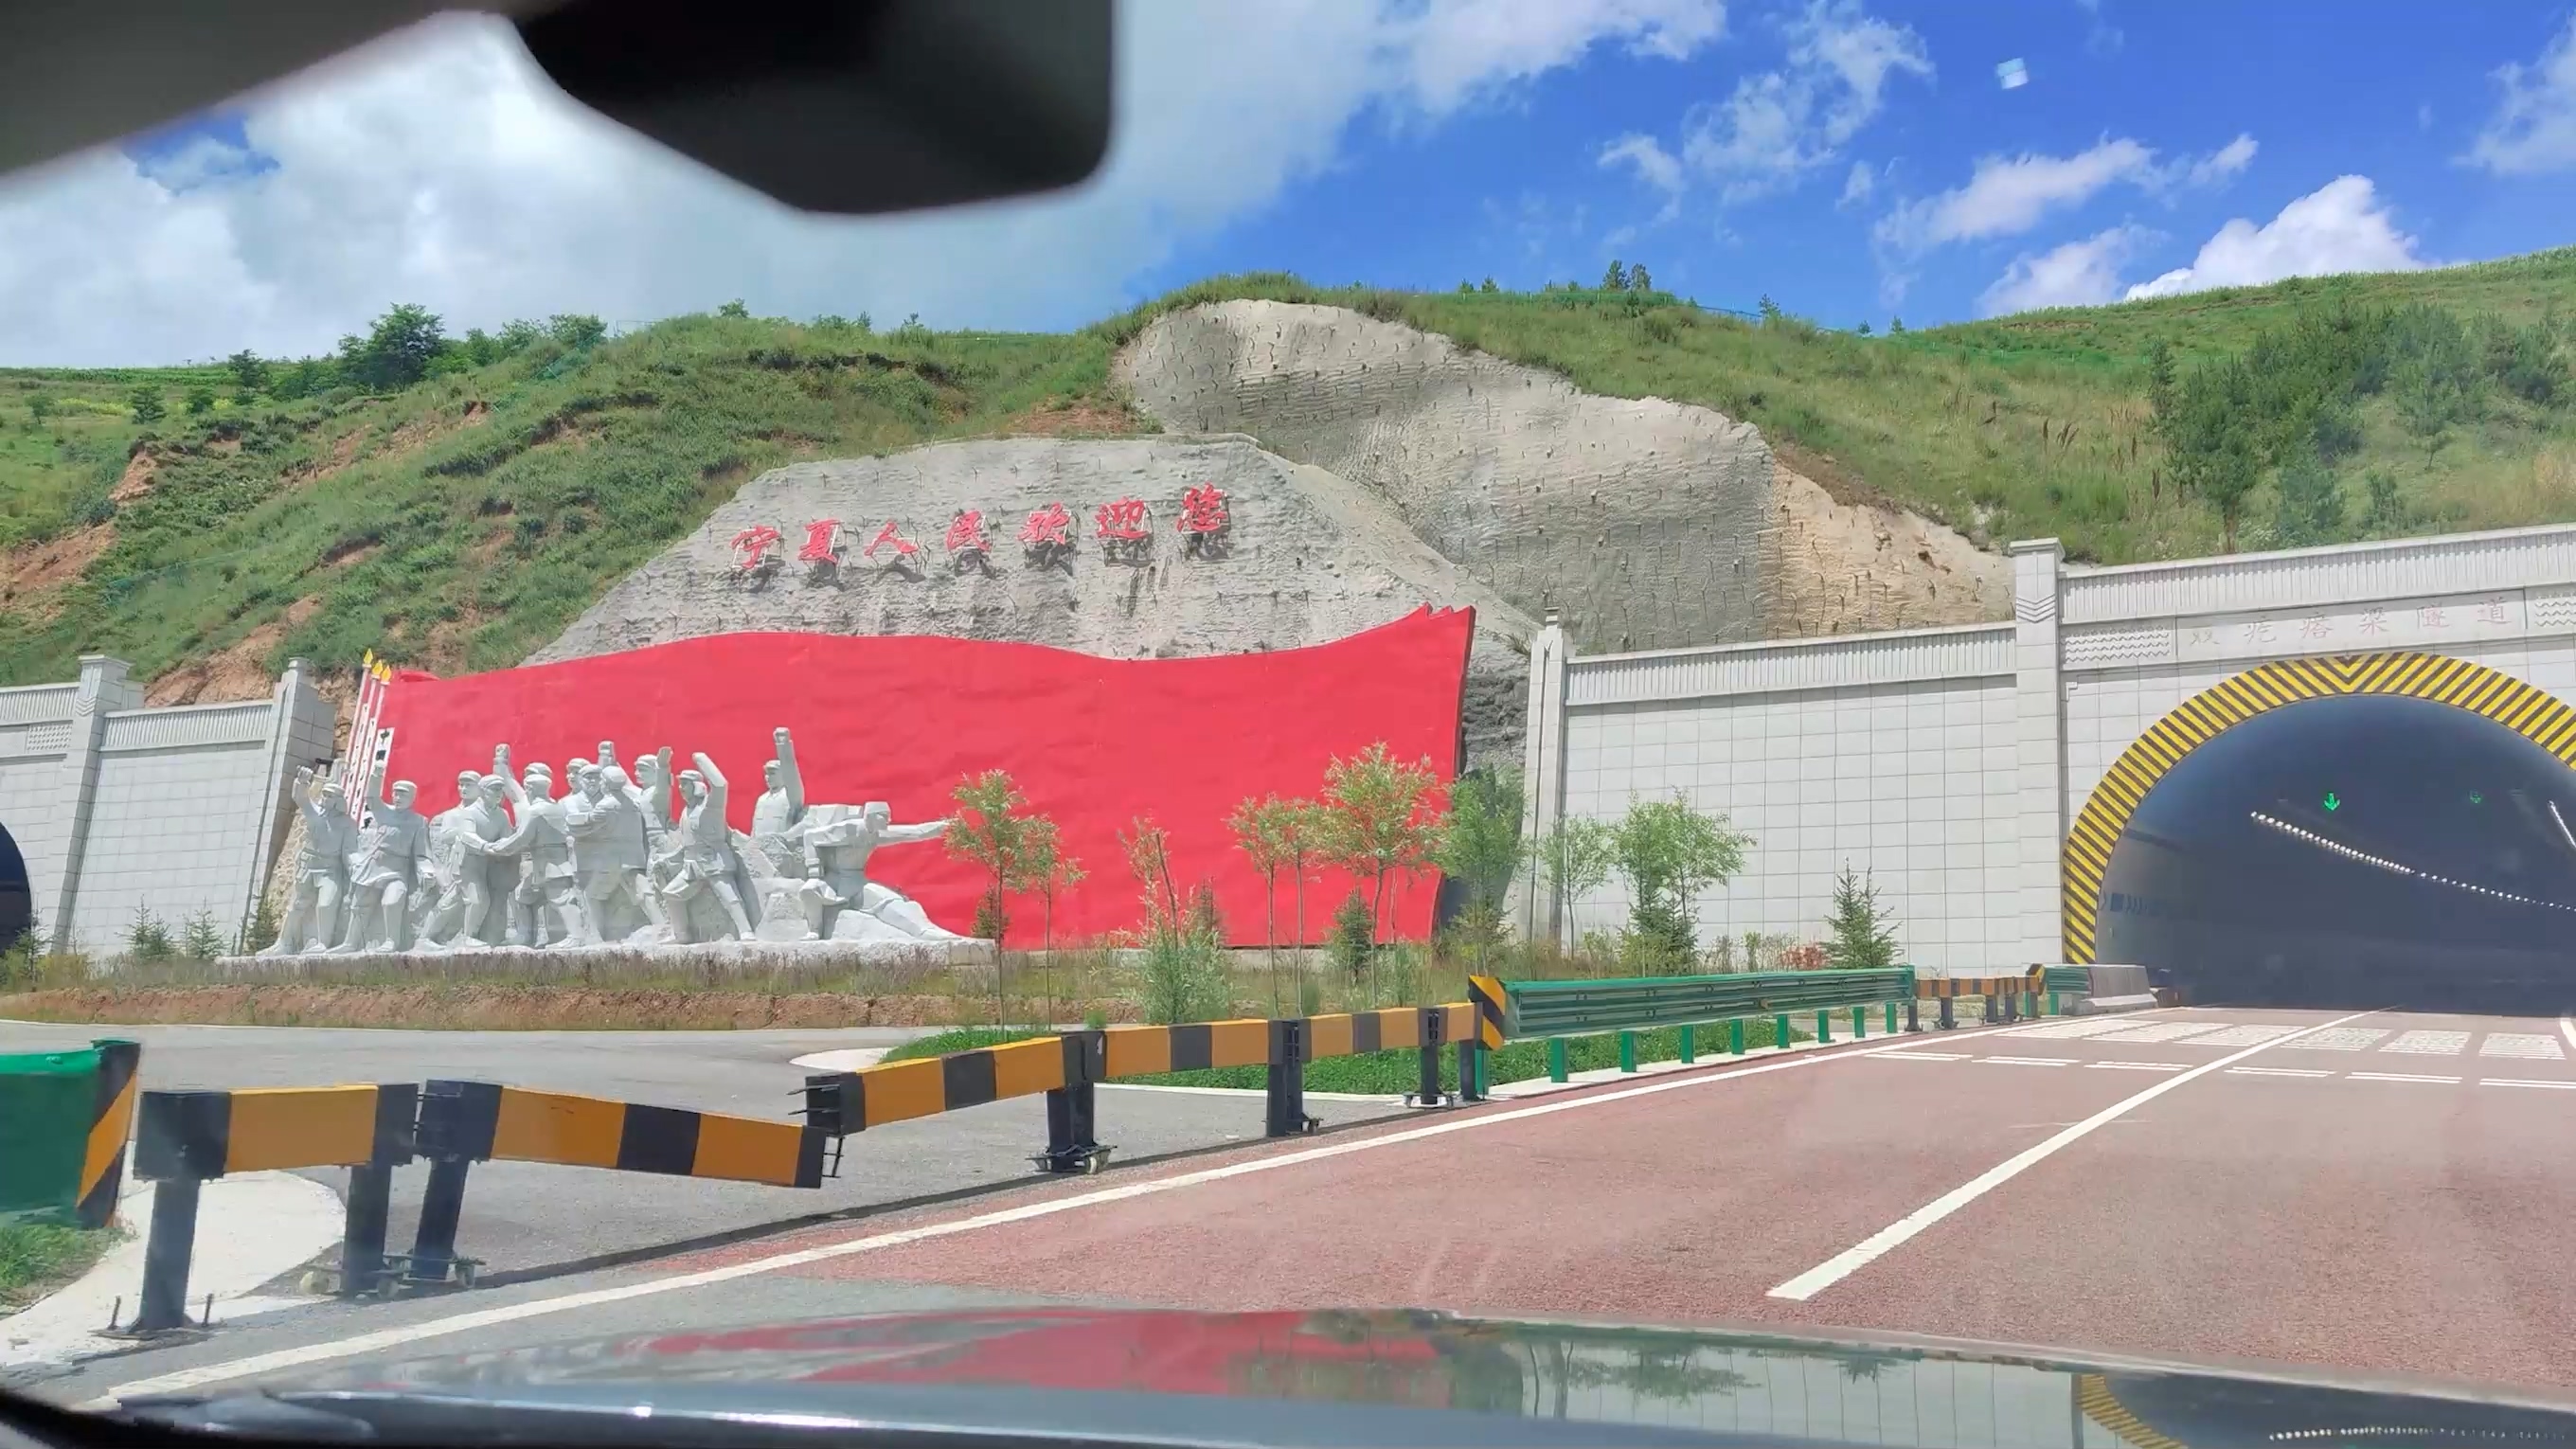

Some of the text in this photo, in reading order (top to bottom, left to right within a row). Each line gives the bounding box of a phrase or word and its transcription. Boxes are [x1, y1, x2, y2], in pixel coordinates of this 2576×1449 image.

[730, 482, 1228, 569] 宁夏人民欢迎您
[2190, 597, 2512, 646] 双疙瘩梁隧道
